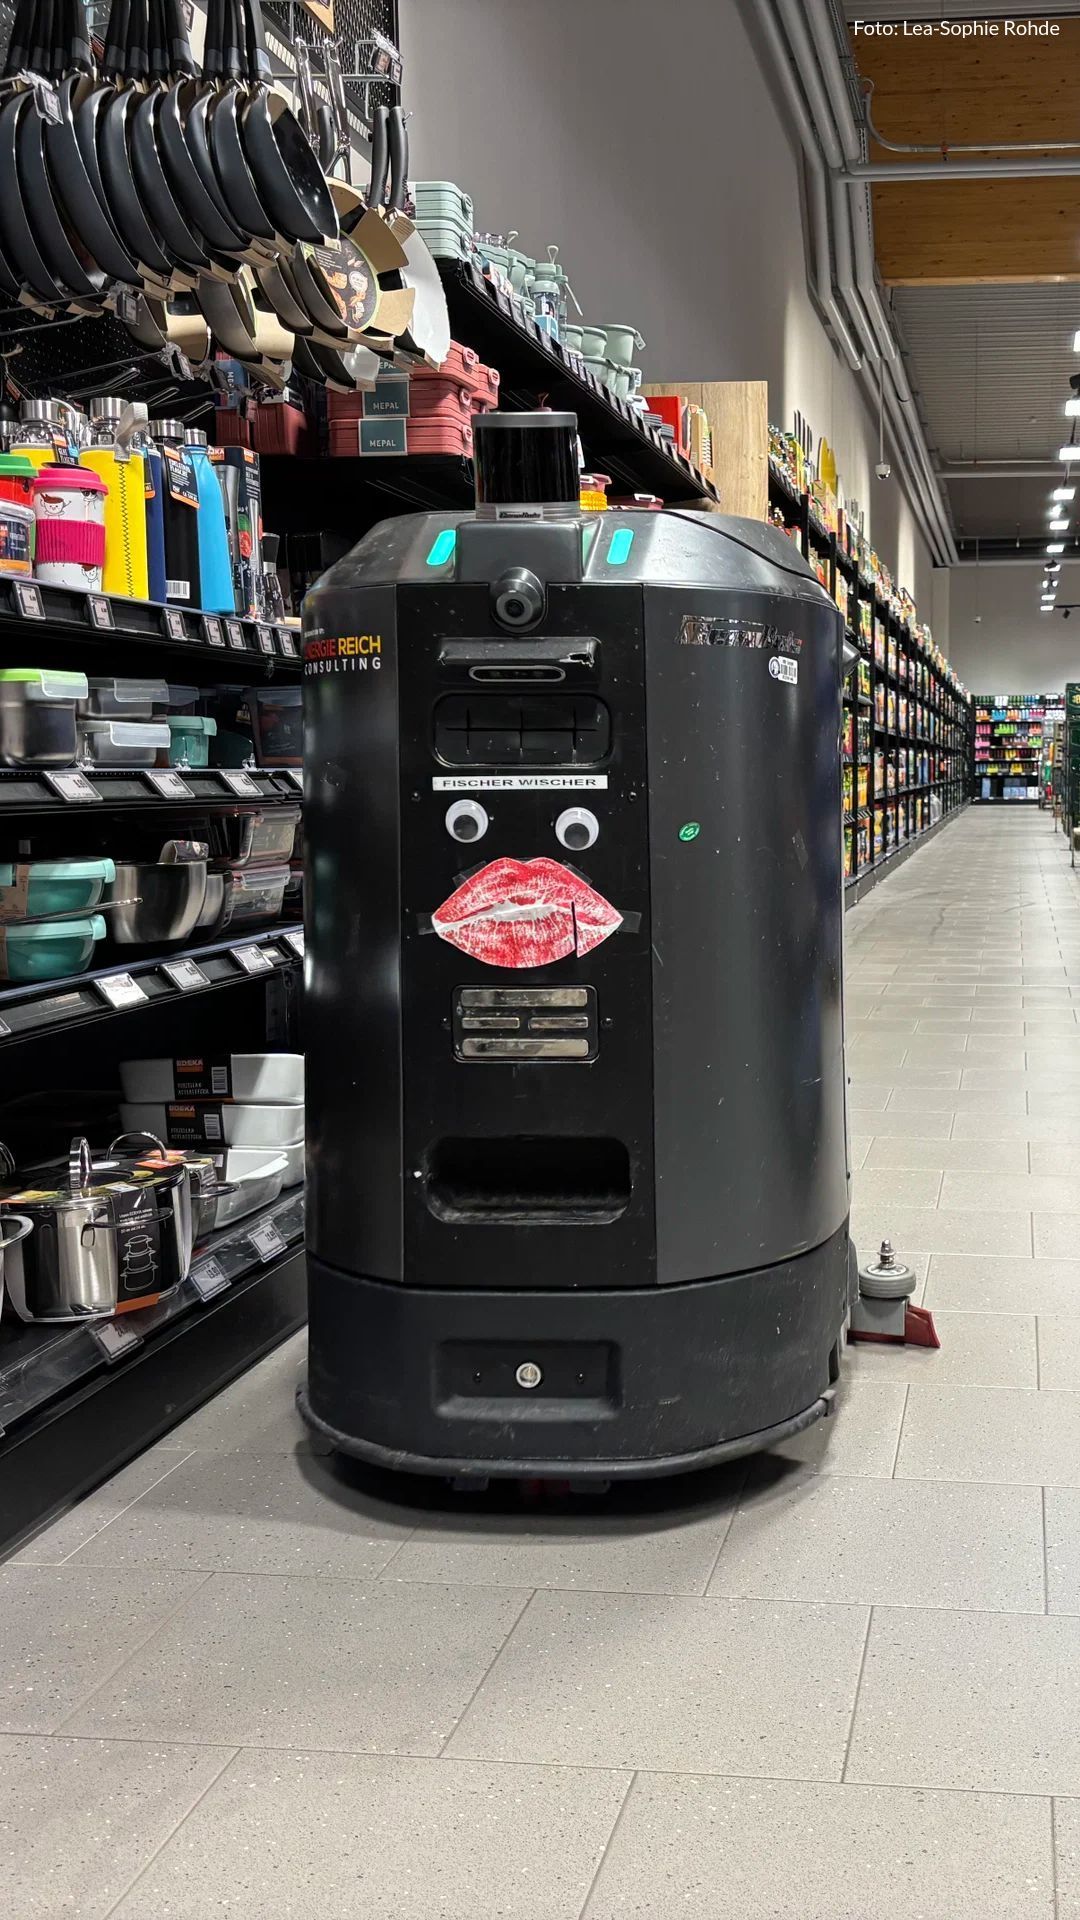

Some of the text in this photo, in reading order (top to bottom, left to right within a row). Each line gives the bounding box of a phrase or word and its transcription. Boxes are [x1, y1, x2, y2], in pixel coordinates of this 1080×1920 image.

[379, 361, 397, 369] EPA
[373, 402, 400, 410] MEPAL
[369, 439, 397, 447] MEPAL
[338, 635, 382, 656] REICH
[304, 656, 381, 676] CONSULTING
[443, 778, 597, 787] FISCHER WISCHER
